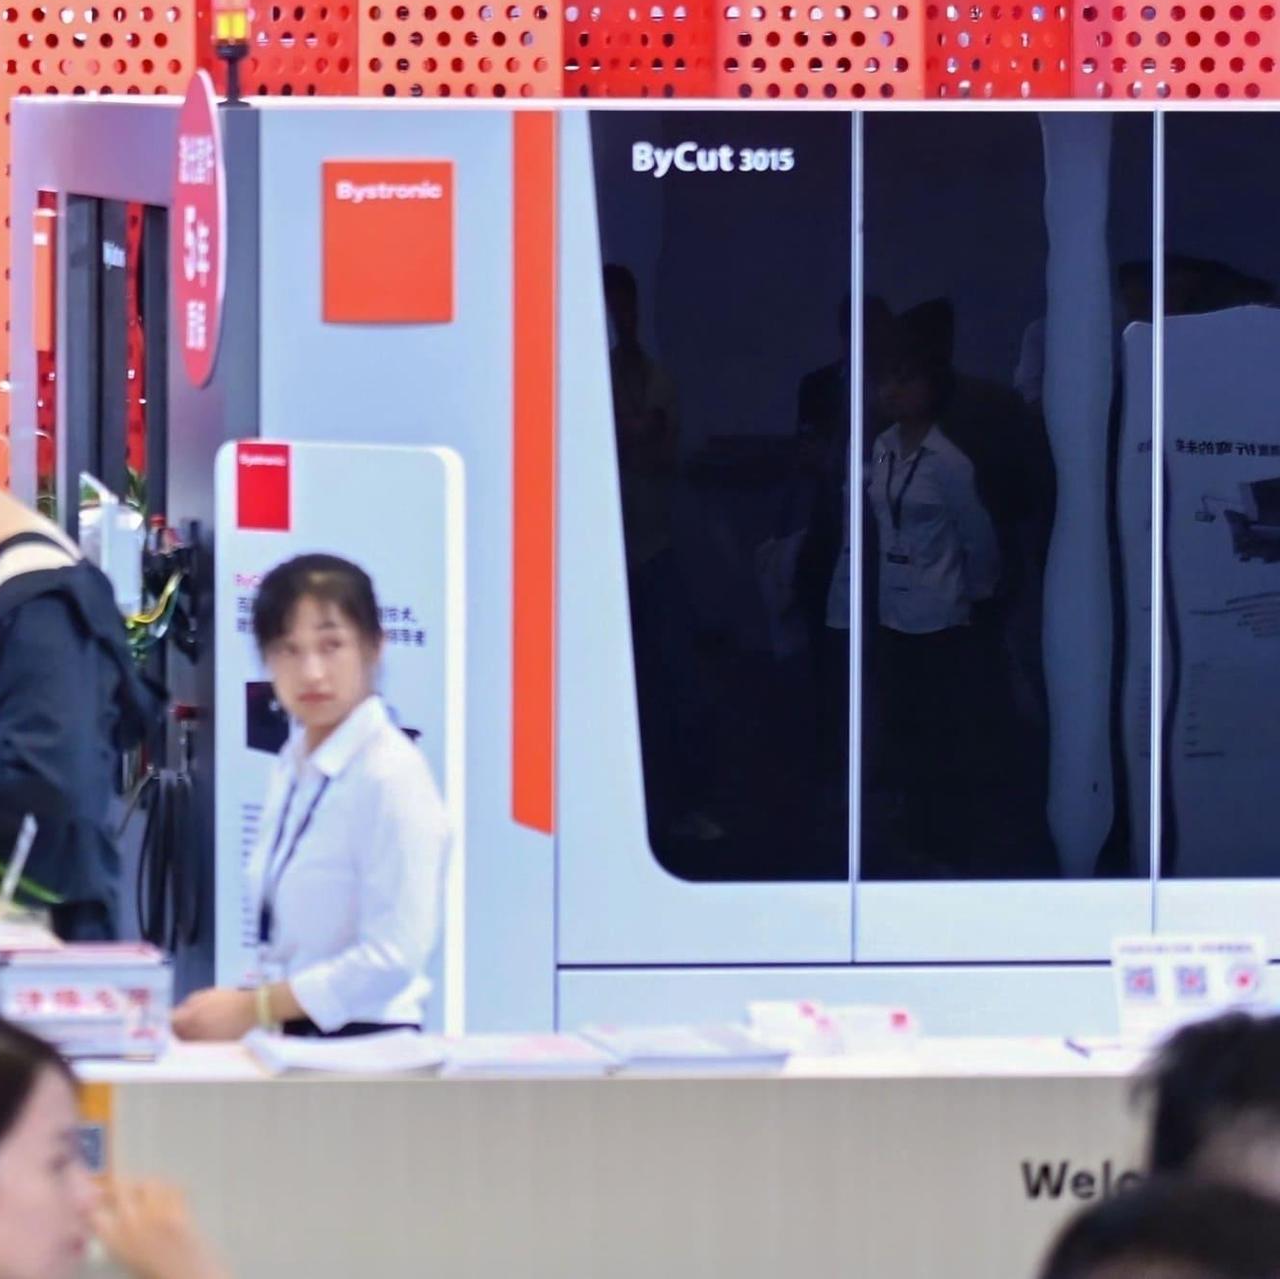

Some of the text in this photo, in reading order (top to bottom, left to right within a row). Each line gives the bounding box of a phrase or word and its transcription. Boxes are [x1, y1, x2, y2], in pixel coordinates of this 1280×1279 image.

[632, 141, 795, 178] ByCut 3015
[335, 179, 443, 204] Bystronic
